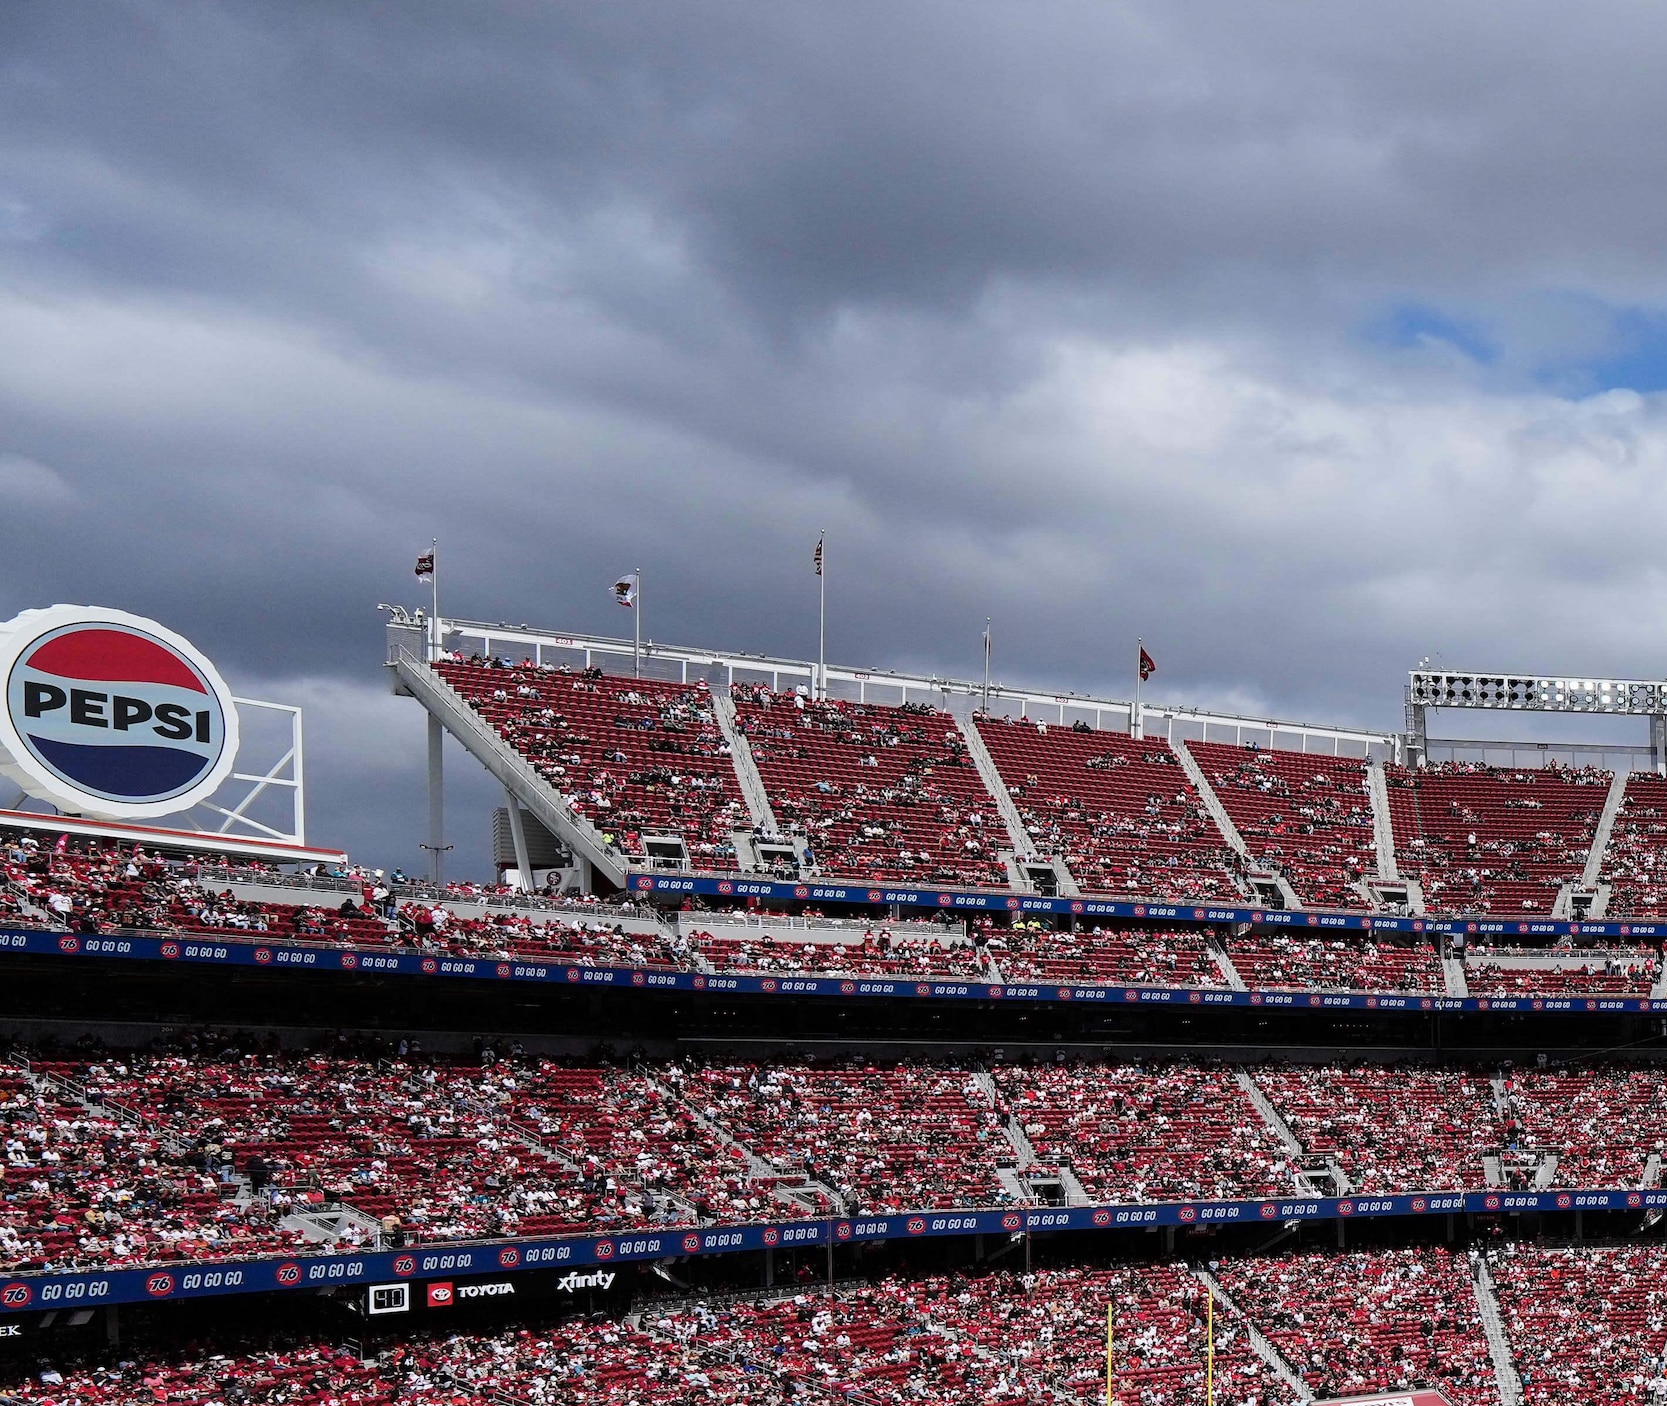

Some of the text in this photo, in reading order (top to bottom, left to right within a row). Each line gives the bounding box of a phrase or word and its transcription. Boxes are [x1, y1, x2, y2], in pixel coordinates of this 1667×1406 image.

[23, 682, 211, 743] PEPSI
[639, 878, 693, 890] 76 GO GO GO
[62, 940, 131, 953] 76 GO GO GO
[149, 1271, 242, 1291] 76 GO GO GO
[457, 1283, 515, 1298] TOYOTA
[557, 1270, 616, 1293] xfinity
[376, 1288, 403, 1307] 40
